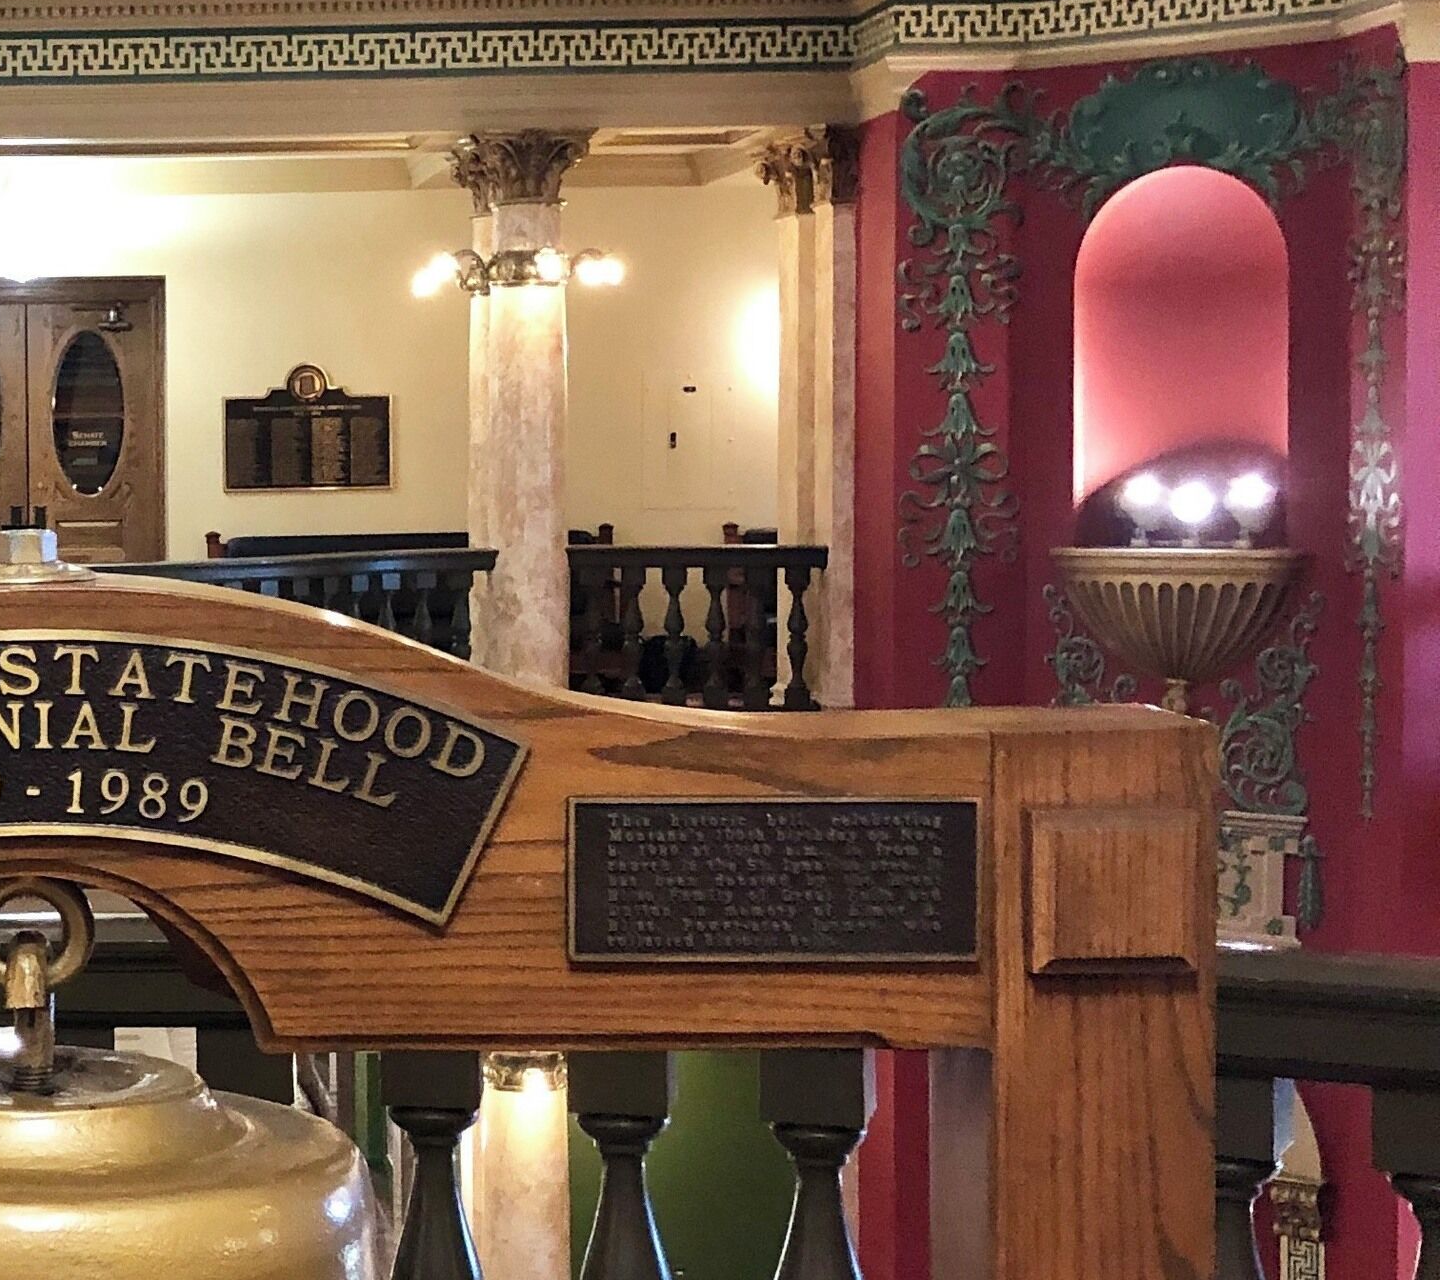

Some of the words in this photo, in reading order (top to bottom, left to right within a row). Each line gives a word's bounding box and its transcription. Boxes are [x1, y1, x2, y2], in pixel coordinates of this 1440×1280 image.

[71, 430, 104, 439] SENATE
[67, 439, 107, 447] CHAMBER
[211, 716, 398, 808] BELL
[66, 767, 210, 823] 1989
[607, 812, 651, 827] This
[669, 812, 748, 827] historic
[608, 828, 705, 842] Montana's
